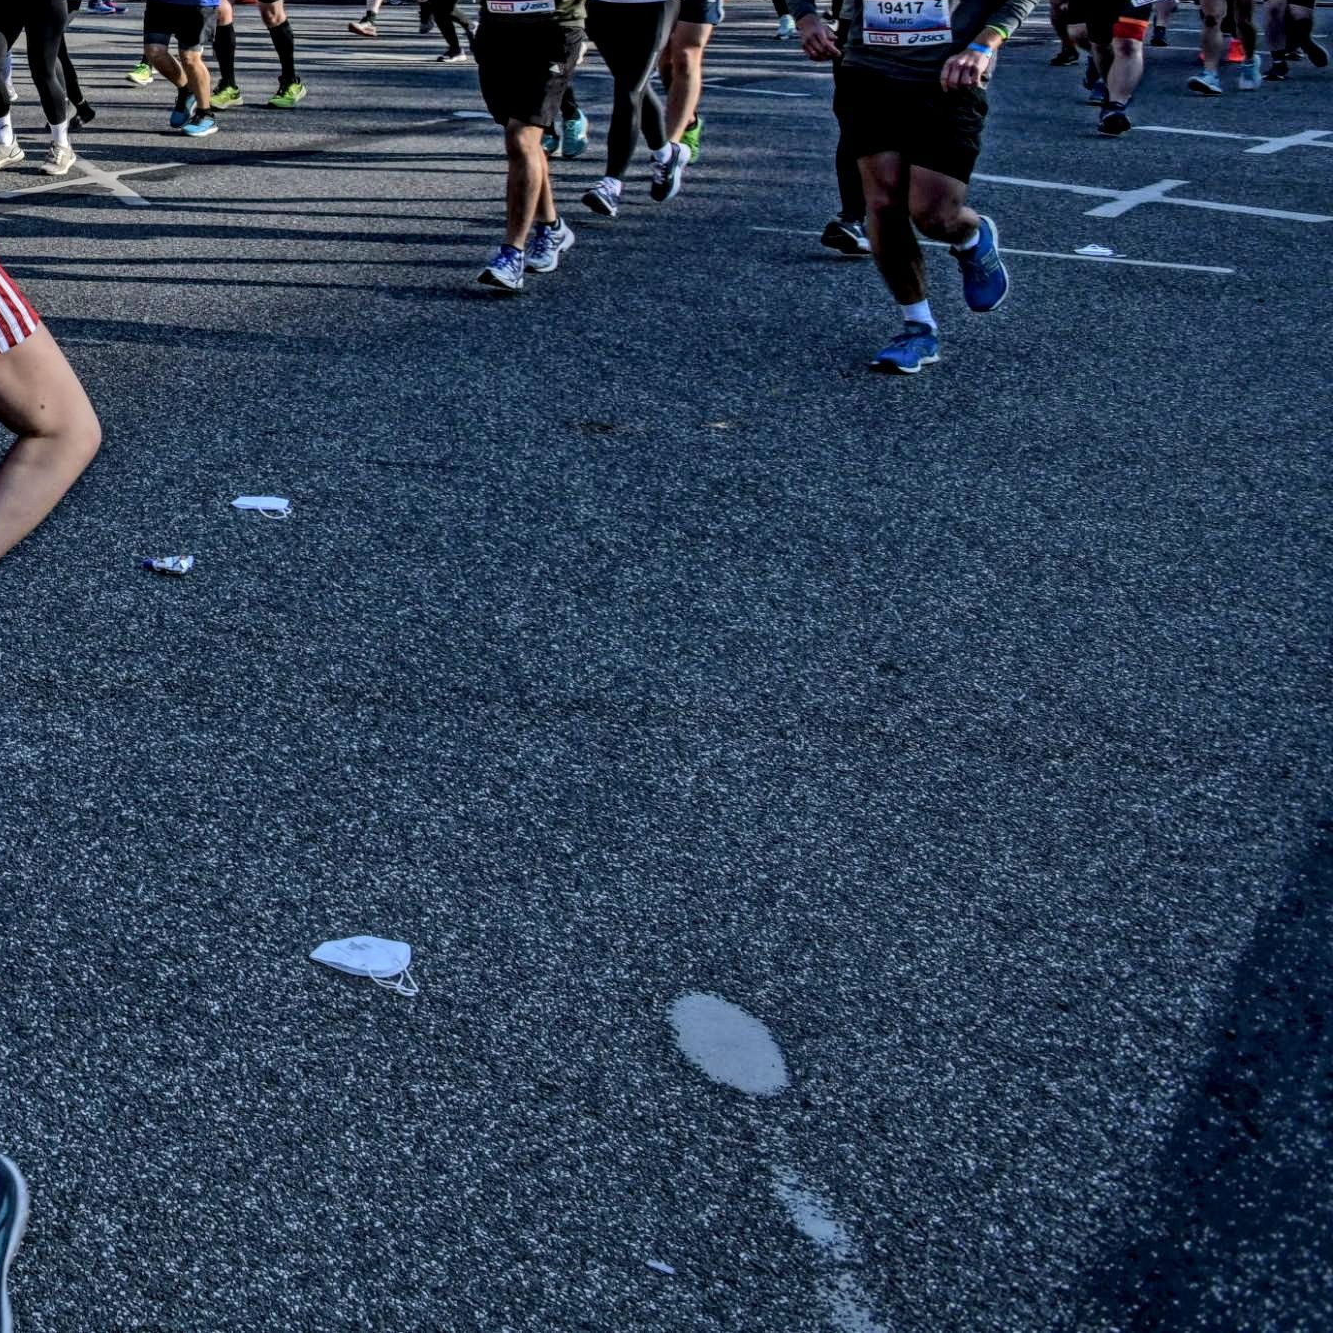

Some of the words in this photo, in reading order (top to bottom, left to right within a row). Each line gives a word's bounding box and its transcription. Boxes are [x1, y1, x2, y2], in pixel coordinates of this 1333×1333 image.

[877, 1, 924, 15] 19417
[889, 16, 913, 25] Marc
[920, 34, 945, 43] asics
